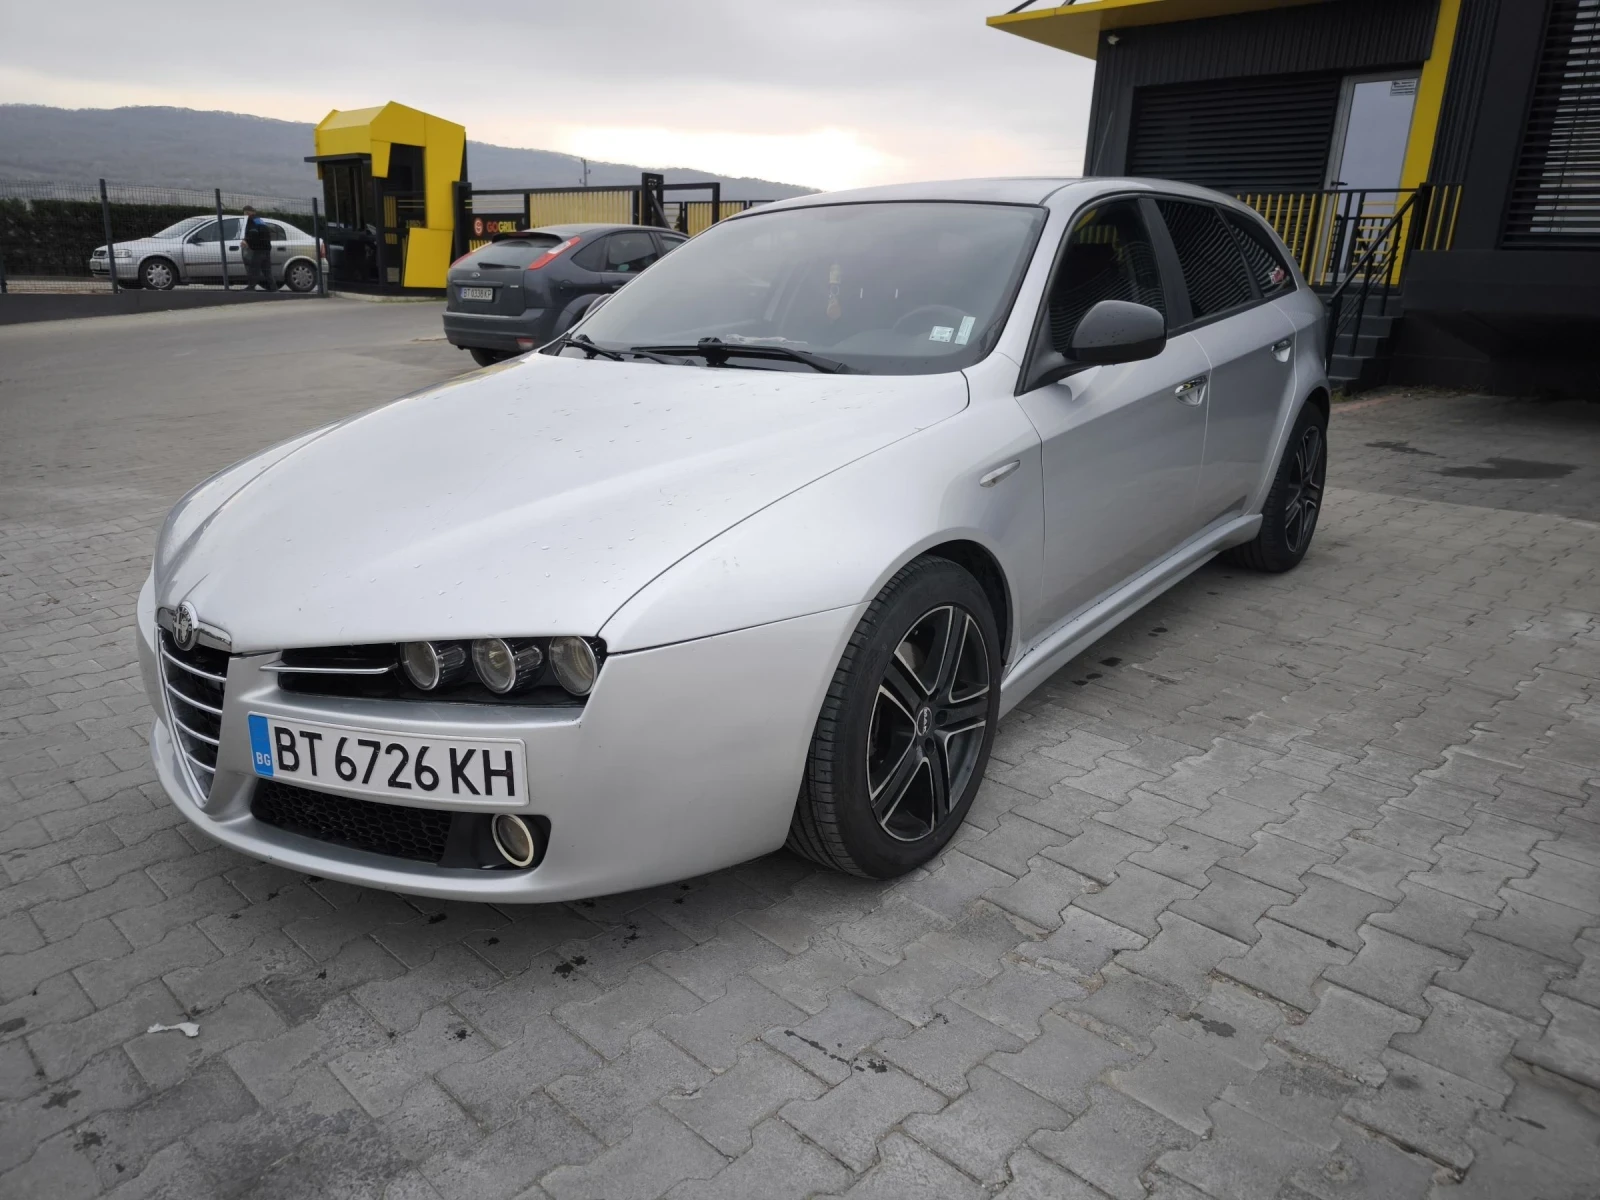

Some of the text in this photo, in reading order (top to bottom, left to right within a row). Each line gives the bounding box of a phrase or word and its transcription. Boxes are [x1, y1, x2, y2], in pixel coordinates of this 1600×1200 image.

[255, 751, 271, 766] BG
[274, 726, 516, 797] BT 6726 KH
